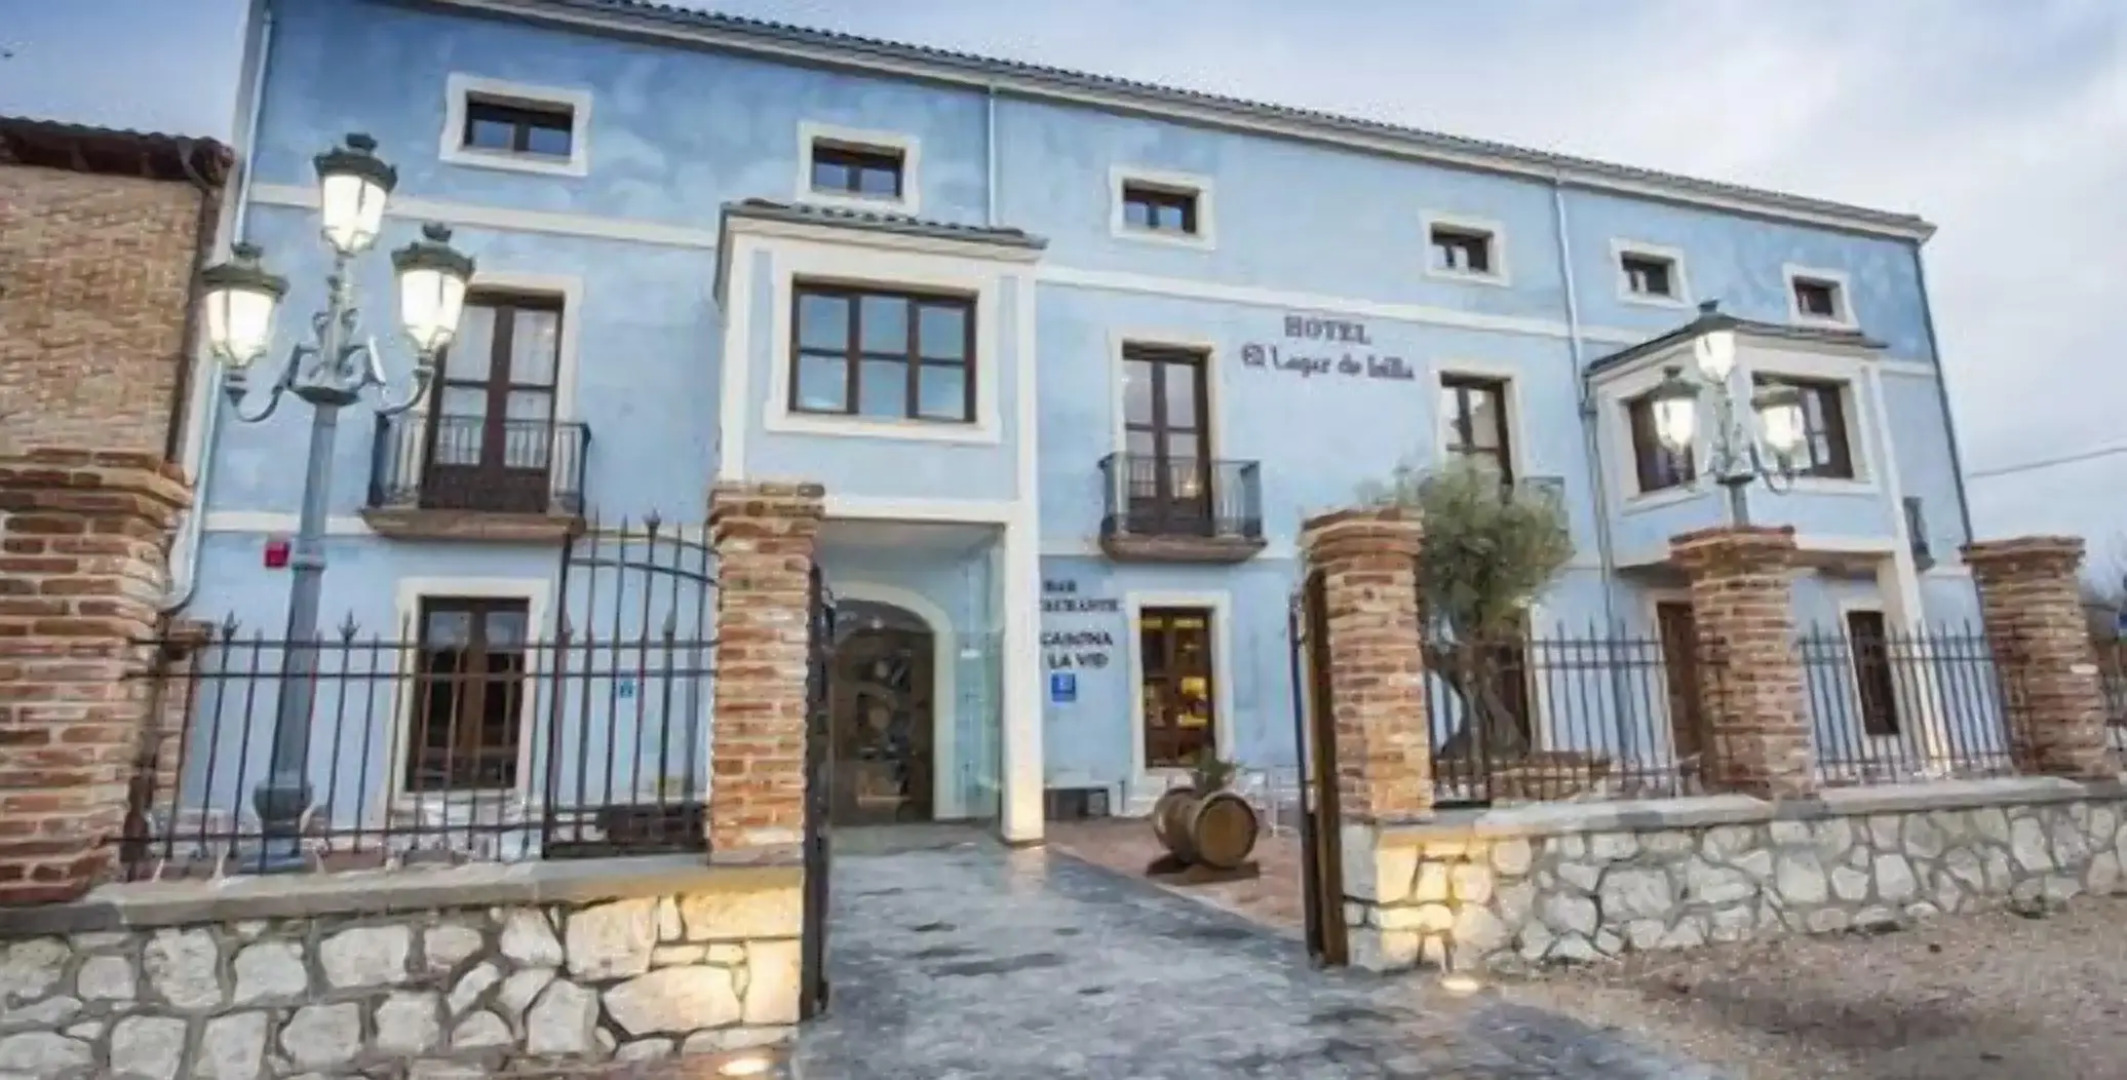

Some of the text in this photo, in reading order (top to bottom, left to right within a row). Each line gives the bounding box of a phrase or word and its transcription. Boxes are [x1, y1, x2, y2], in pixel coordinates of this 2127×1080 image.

[1284, 315, 1371, 345] HOTEL
[1044, 580, 1076, 593] BAR
[1047, 654, 1072, 669] LA
